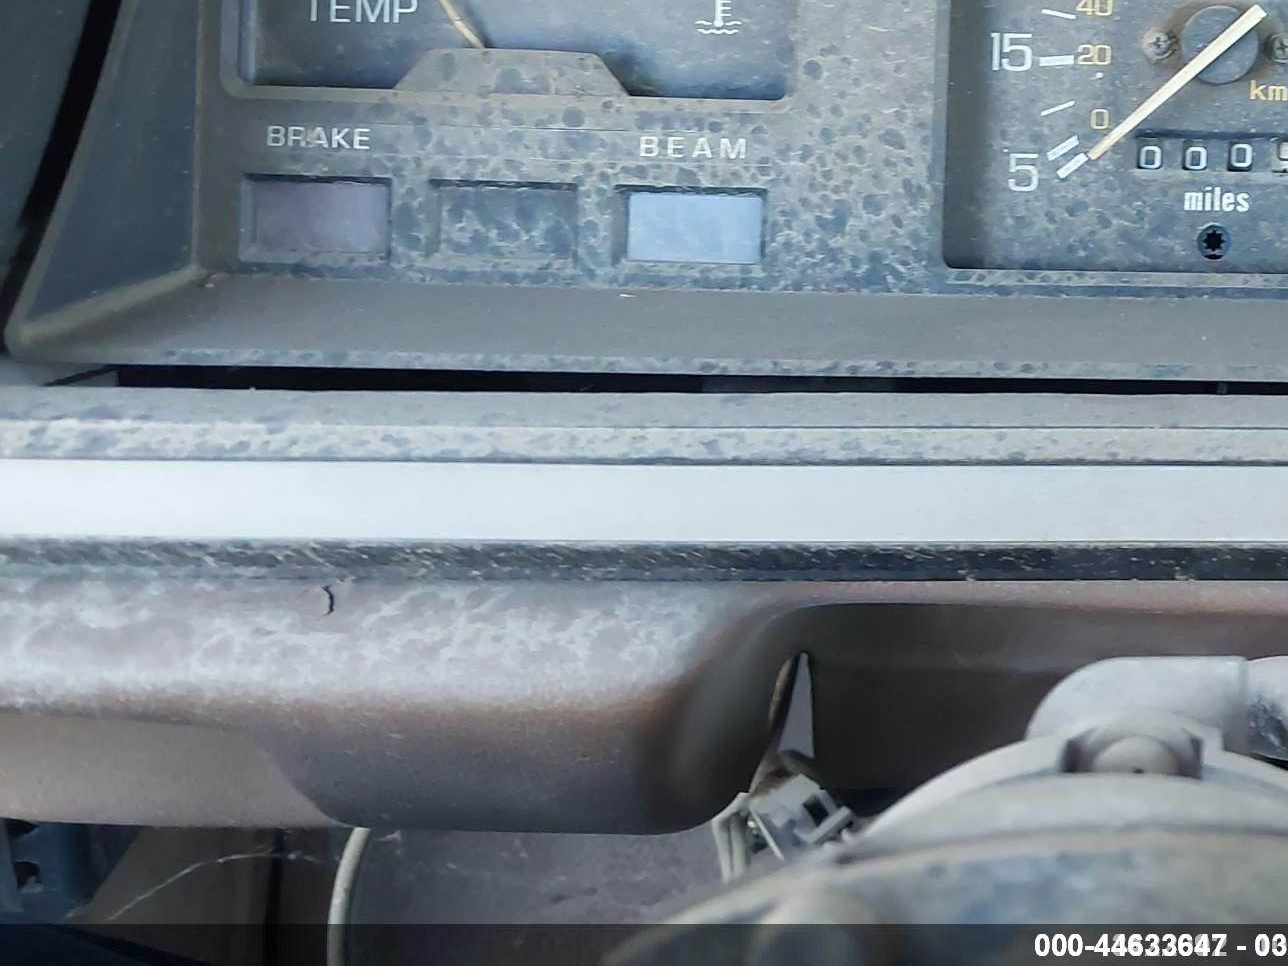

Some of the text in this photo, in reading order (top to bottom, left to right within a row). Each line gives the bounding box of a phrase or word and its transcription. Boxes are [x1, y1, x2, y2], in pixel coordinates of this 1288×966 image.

[990, 32, 1033, 72] 15
[1077, 44, 1112, 67] 20
[266, 125, 371, 151] BRAKE
[639, 135, 747, 160] BEAM
[1008, 154, 1039, 192] 5
[1183, 186, 1250, 213] miles
